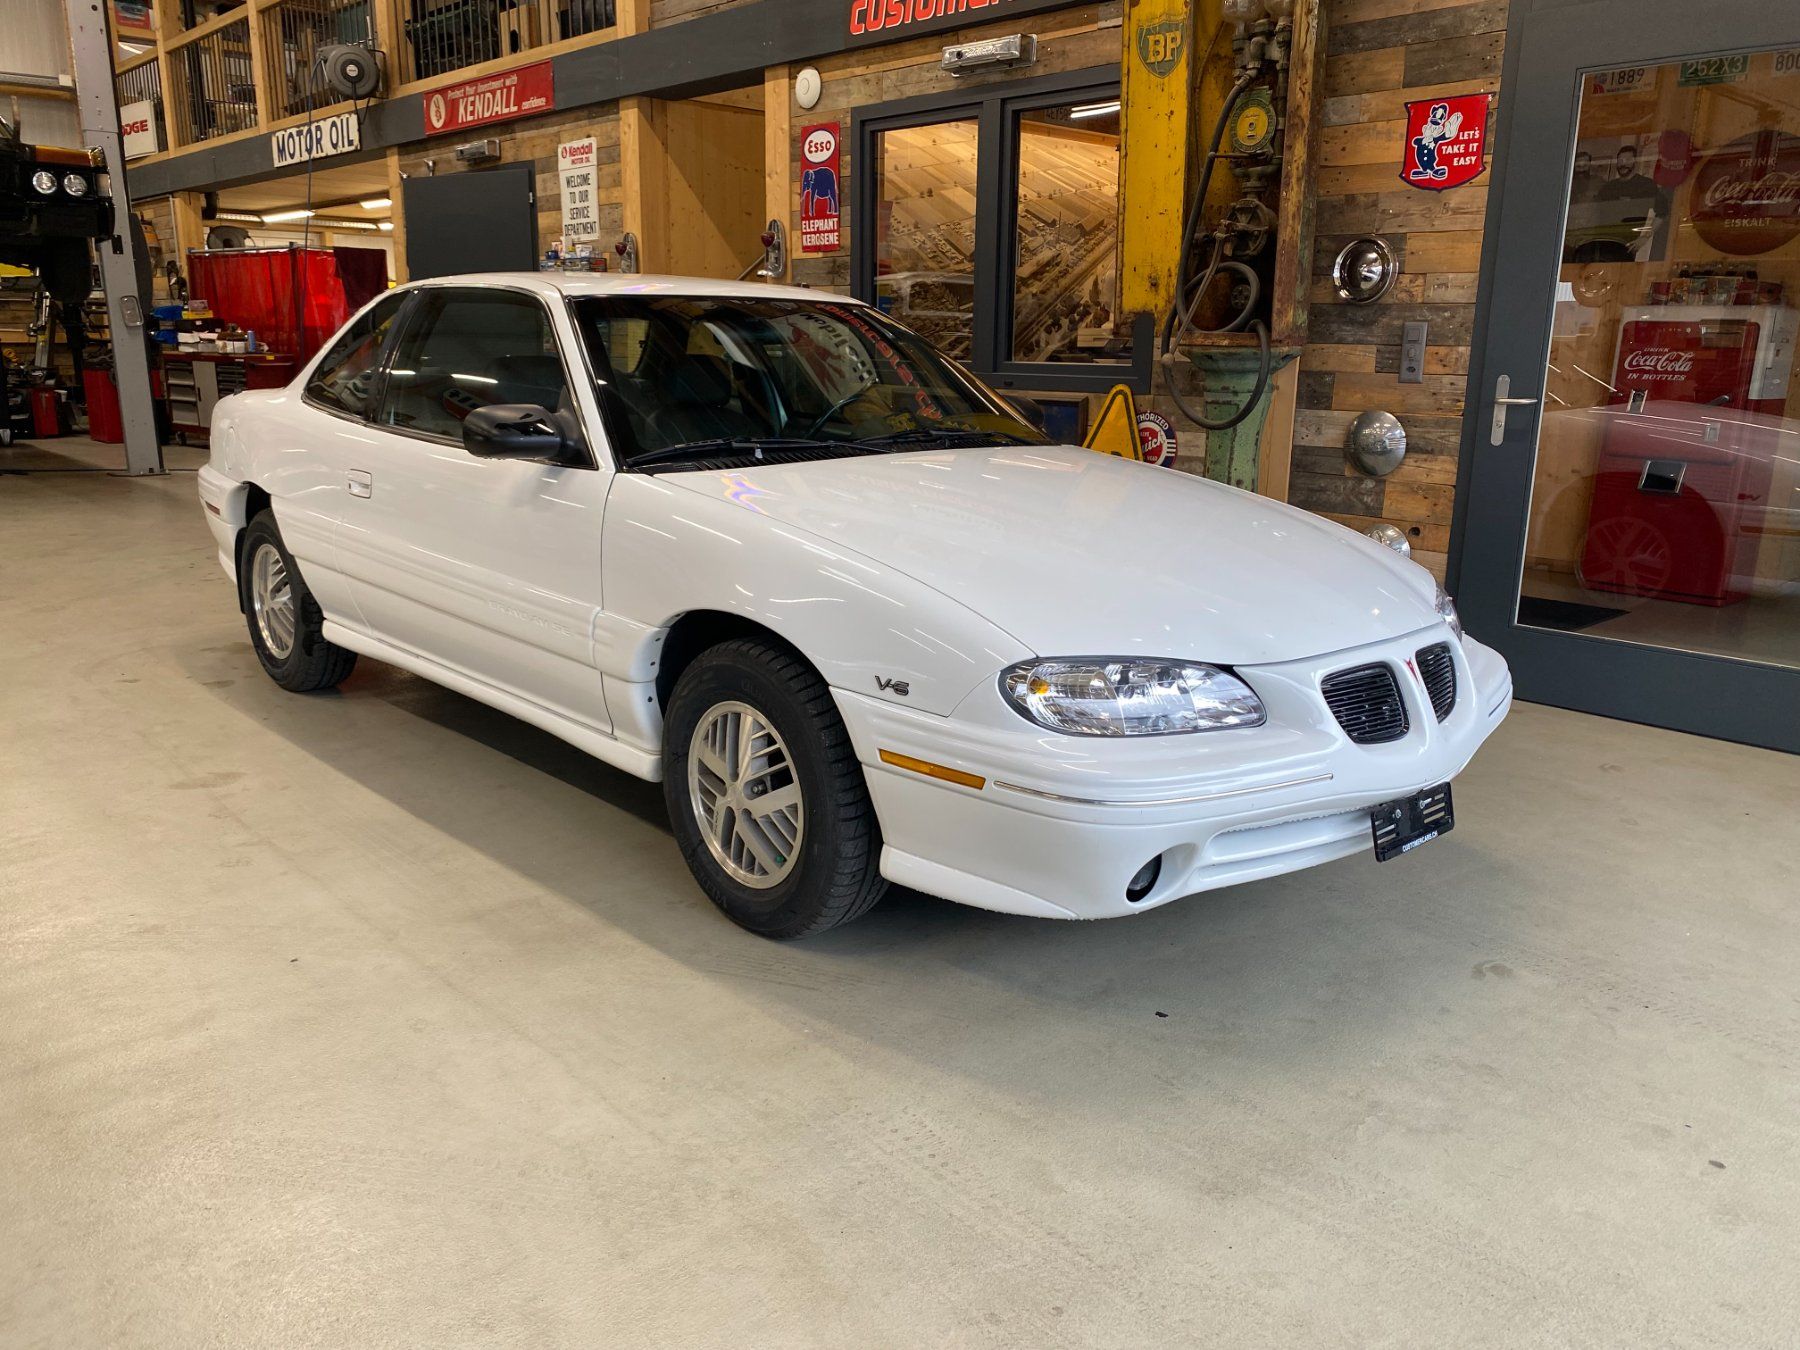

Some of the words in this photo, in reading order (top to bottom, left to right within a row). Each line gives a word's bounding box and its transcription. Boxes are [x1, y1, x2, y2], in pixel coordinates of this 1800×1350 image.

[1146, 30, 1181, 63] BP
[1610, 68, 1645, 86] 1889
[458, 86, 518, 123] KENDALL
[121, 119, 149, 137] DGE
[276, 124, 324, 163] MOTOR
[330, 117, 354, 150] OIL
[807, 139, 832, 154] Esso
[568, 142, 593, 157] Kendall
[1441, 144, 1466, 155] TAKE
[1468, 142, 1479, 152] IT
[1453, 155, 1477, 166] EASY
[565, 172, 591, 189] WELCOME
[569, 191, 577, 204] TO
[578, 189, 590, 203] OUR
[569, 205, 590, 220] SERVICE
[564, 220, 597, 236] DEPARTMENT
[802, 218, 838, 232] ELEPHANT
[1724, 217, 1772, 228] EISKALT
[803, 233, 839, 246] KEROSENE
[1624, 350, 1695, 372] Coca-Cola
[1642, 373, 1687, 381] BOTTLES
[1137, 411, 1169, 430] THORIZED
[1141, 430, 1166, 453] uick
